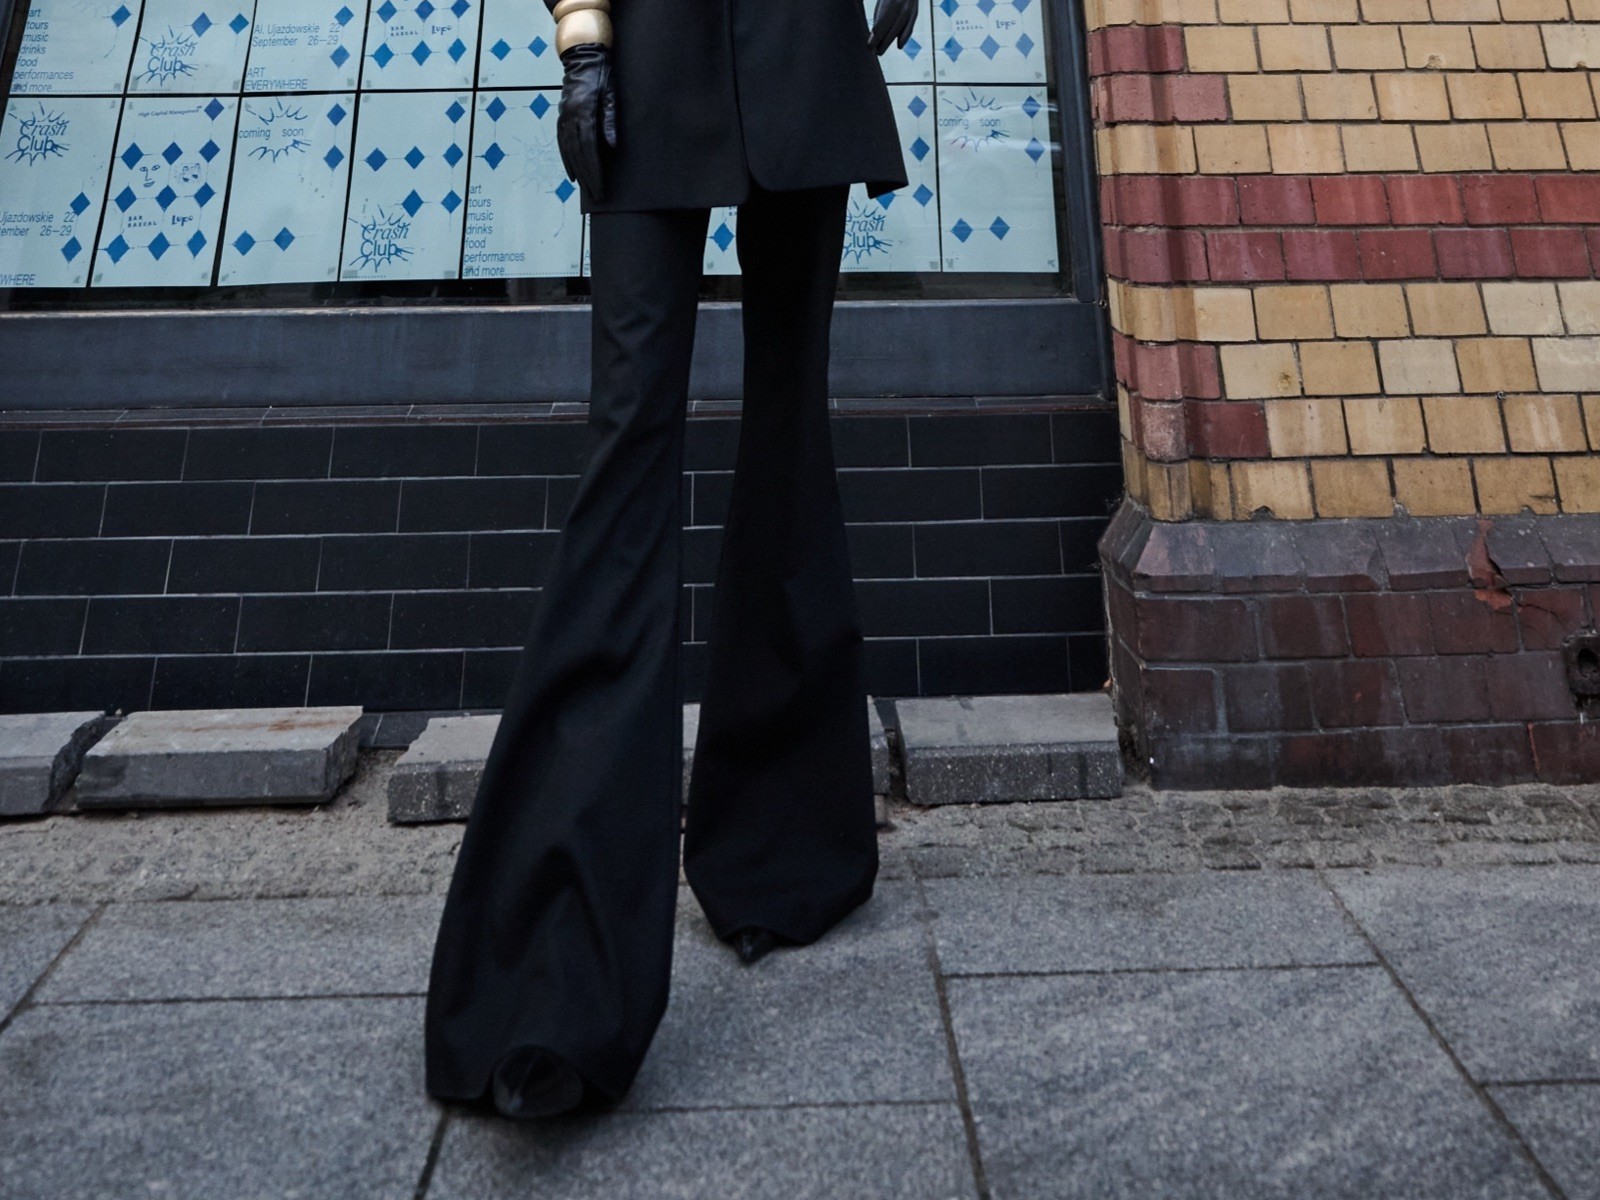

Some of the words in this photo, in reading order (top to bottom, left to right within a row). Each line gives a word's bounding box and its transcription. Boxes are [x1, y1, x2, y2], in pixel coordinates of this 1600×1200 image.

[28, 9, 41, 18] art
[26, 21, 49, 31] tours
[254, 23, 266, 34] Al.
[268, 23, 320, 36] Ujazdowskie
[329, 22, 341, 33] 22
[23, 33, 49, 42] music
[251, 36, 298, 49] September
[20, 44, 46, 55] drinks
[150, 42, 196, 57] Crash
[17, 57, 38, 68] food
[147, 55, 184, 72] Club
[13, 70, 74, 82] performances
[247, 67, 266, 78] ART
[244, 79, 308, 91] EVERYWHERE
[19, 119, 69, 137] Crash
[937, 118, 970, 130] coming
[979, 117, 1002, 128] soon
[238, 127, 271, 141] coming
[281, 127, 305, 138] soon
[16, 134, 55, 153] Club
[469, 184, 483, 195] art
[468, 198, 492, 209] tours
[63, 211, 76, 224] 22
[467, 210, 494, 222] music
[361, 223, 409, 240] Crash
[465, 224, 494, 236] drinks
[359, 239, 397, 258] Club
[464, 237, 487, 250] food
[463, 250, 526, 264] performances
